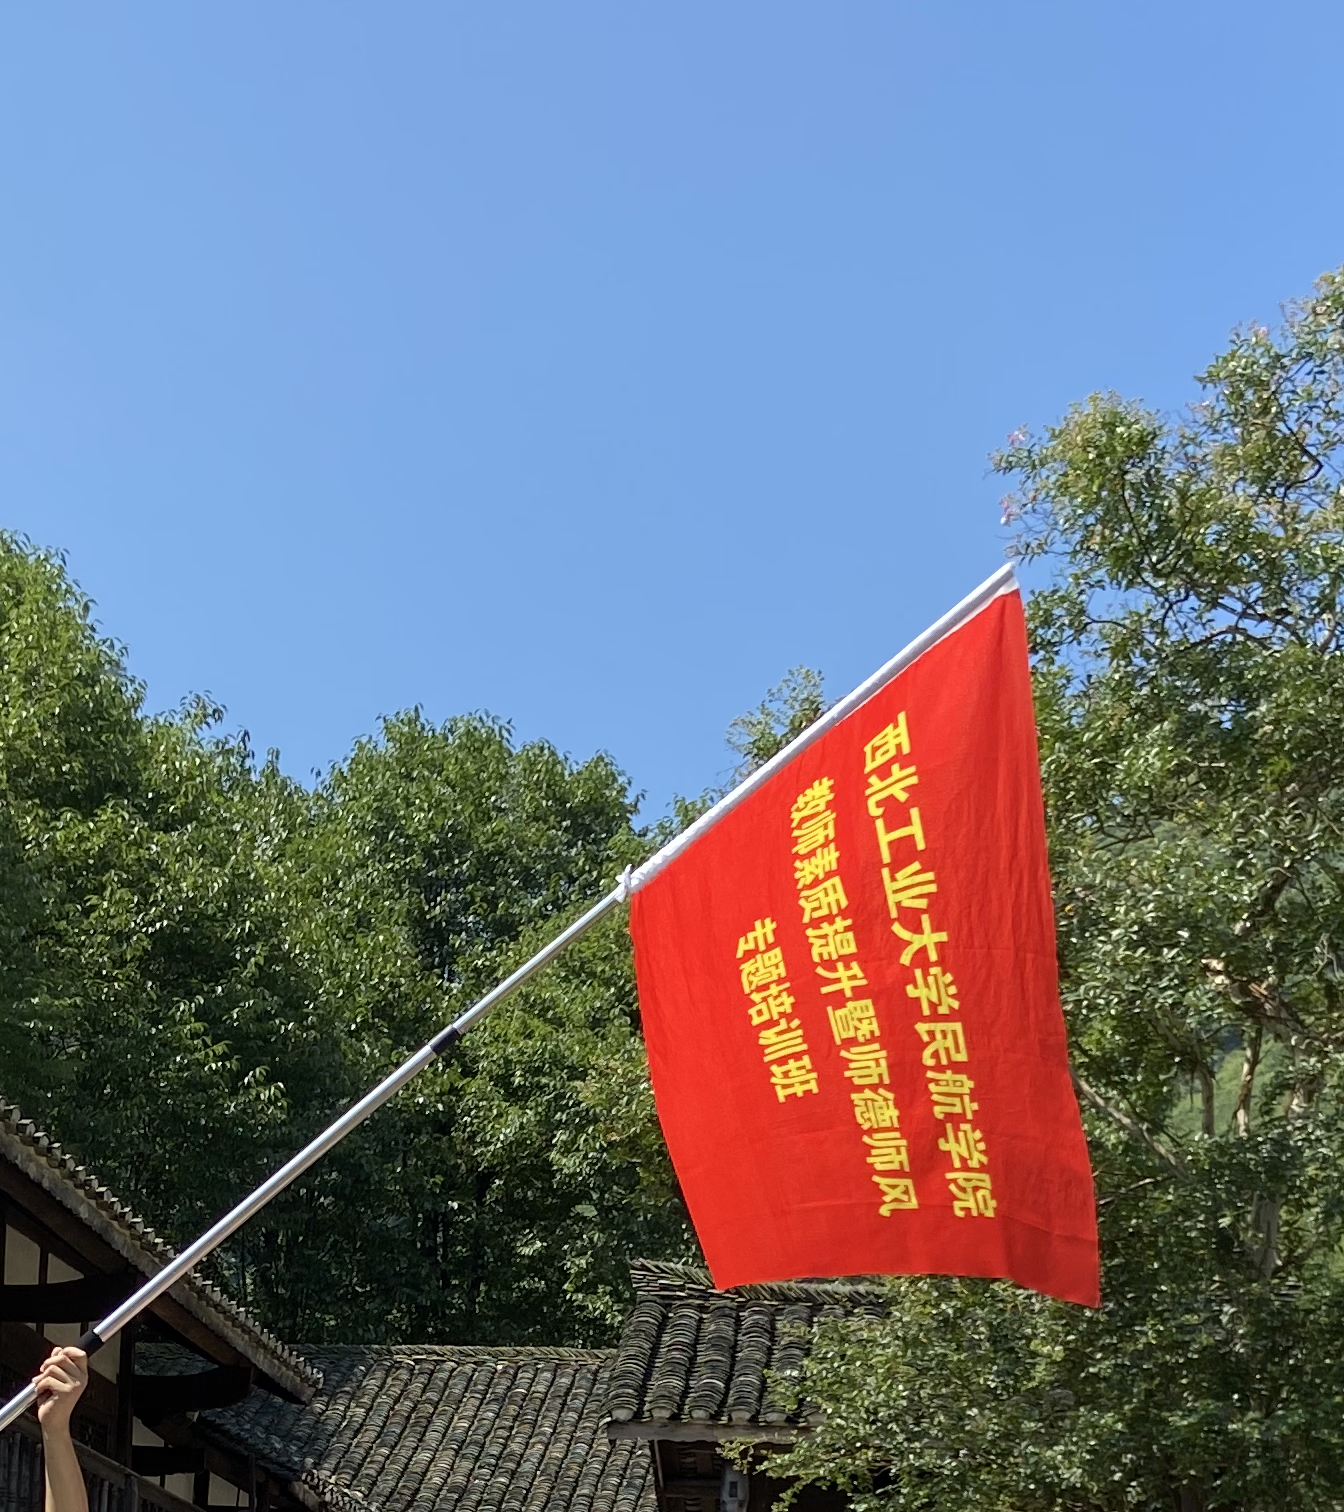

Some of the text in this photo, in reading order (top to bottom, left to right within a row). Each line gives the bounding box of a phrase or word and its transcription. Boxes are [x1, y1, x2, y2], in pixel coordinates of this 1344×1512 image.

[734, 917, 820, 1103] 专题培训班
[789, 775, 920, 1218] 教师素质提升暨师德师风
[862, 711, 998, 1219] 西北工业大学民航学院
